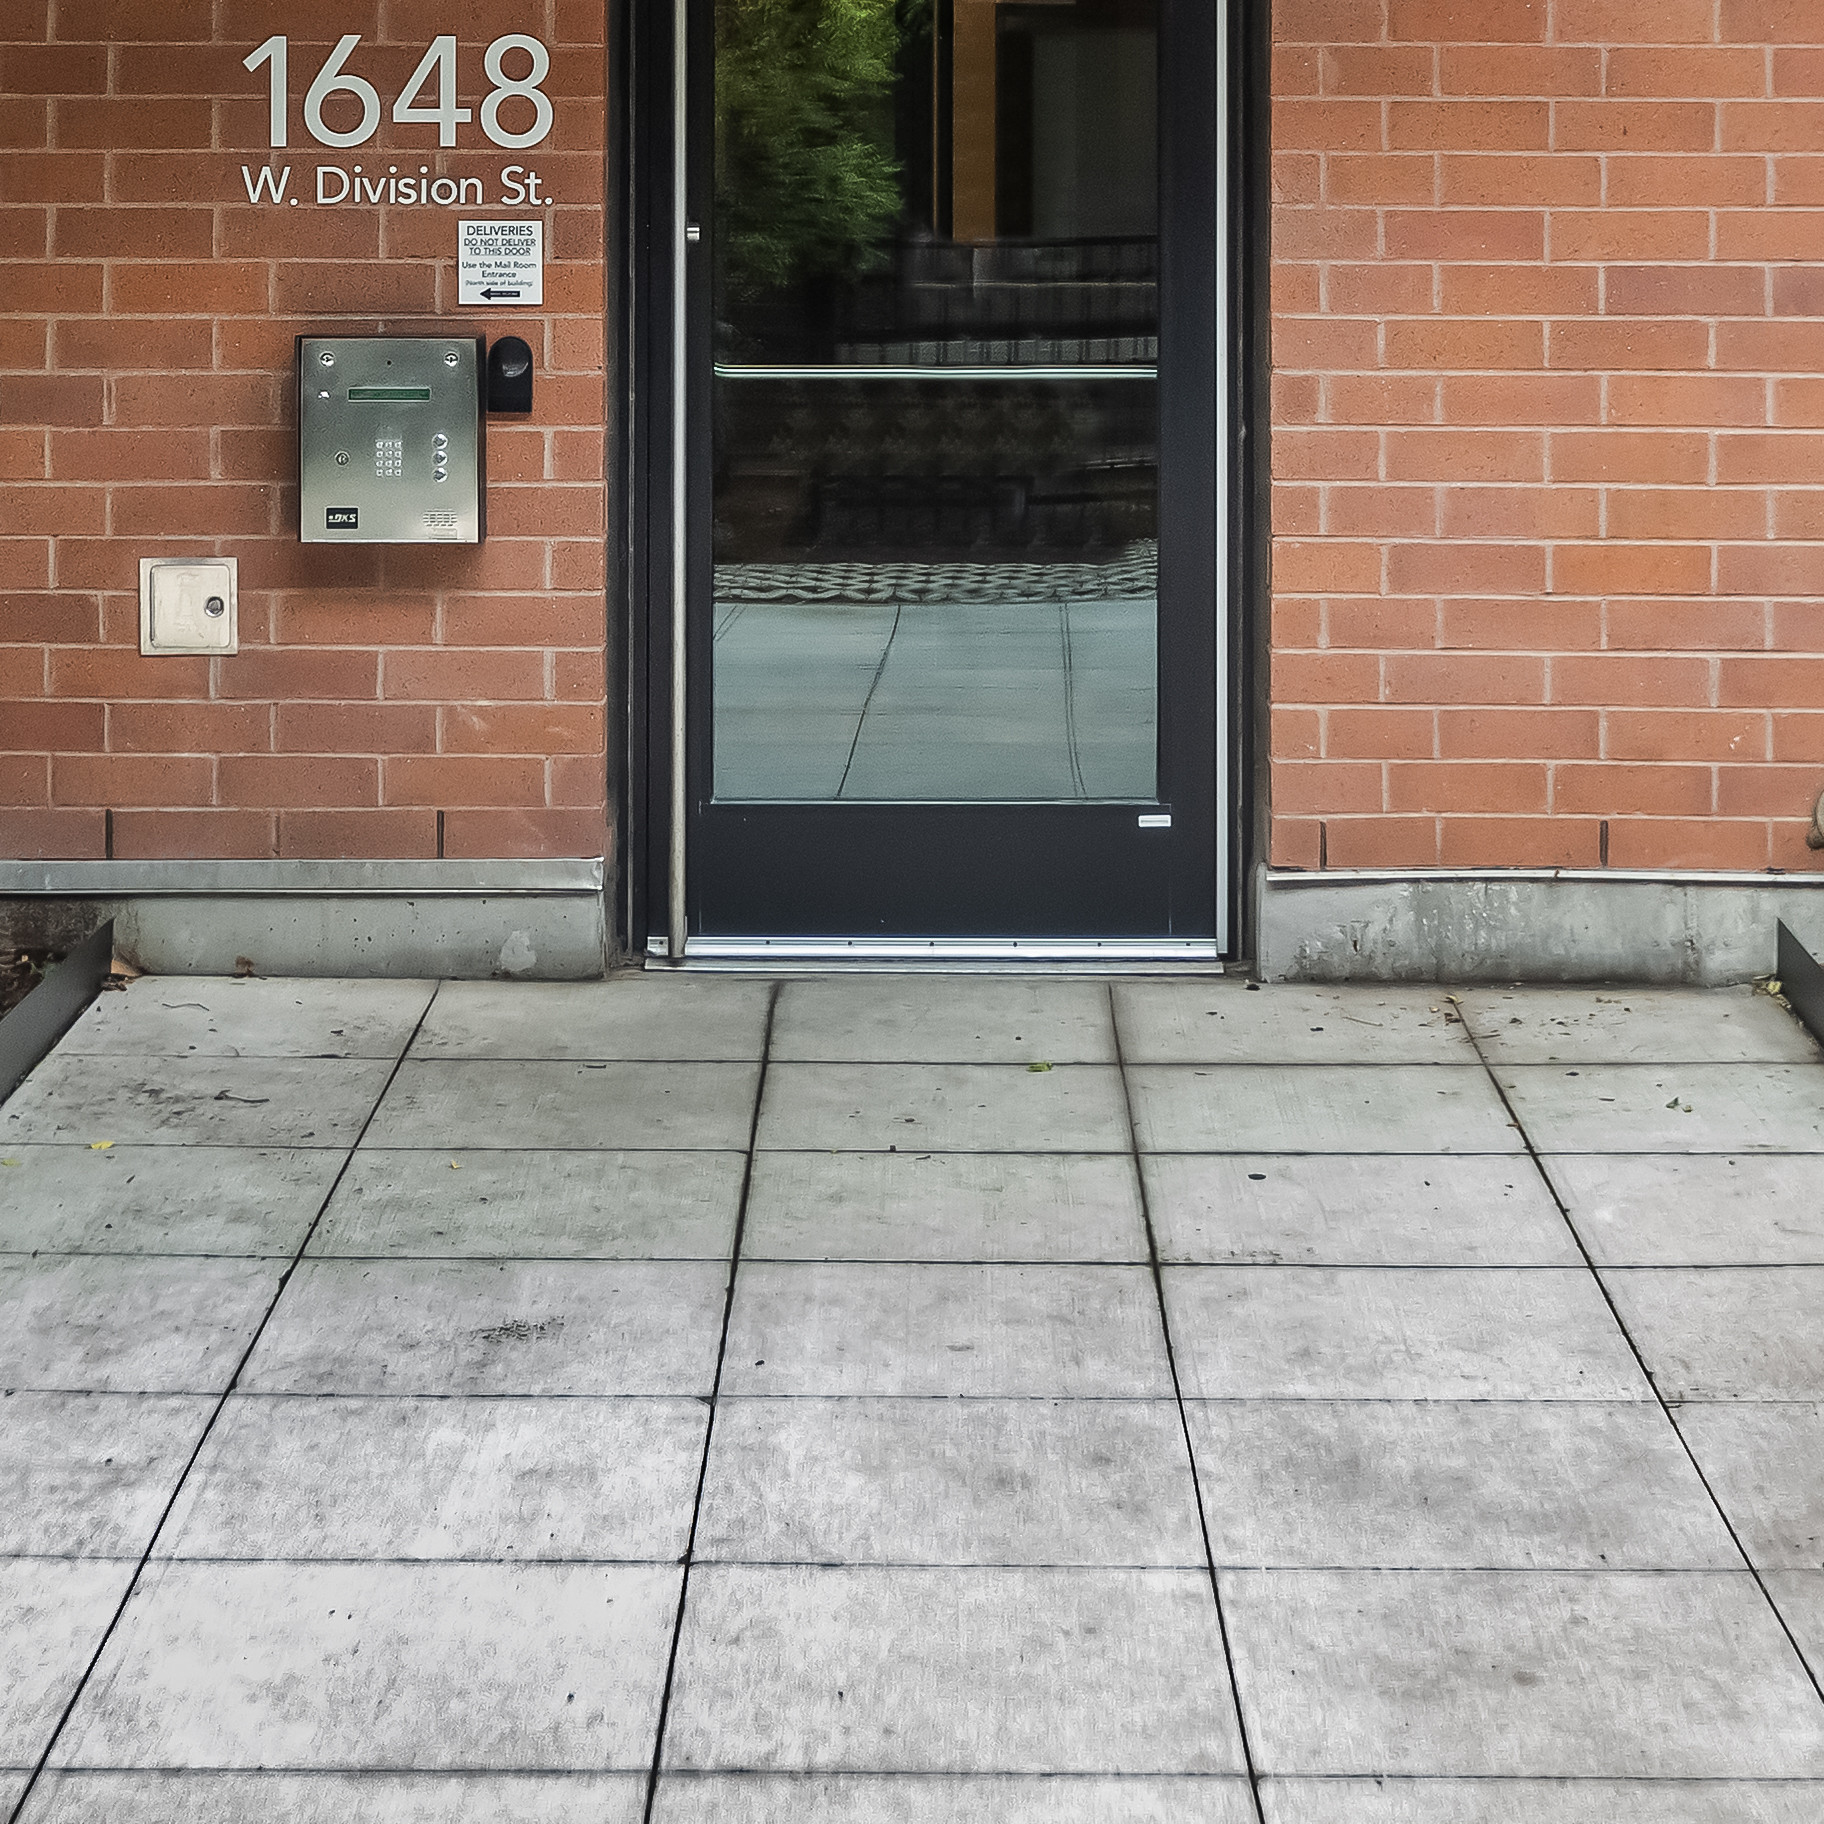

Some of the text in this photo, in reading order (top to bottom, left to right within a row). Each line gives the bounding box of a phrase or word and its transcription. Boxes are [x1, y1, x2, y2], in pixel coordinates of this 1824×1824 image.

[242, 33, 554, 149] 1648
[241, 164, 554, 207] W. Division St.
[466, 225, 534, 237] DELIVERIES
[463, 238, 537, 247] DO NOT DELIVER
[469, 247, 532, 256] TO THIS DOOR
[461, 261, 537, 269] Use the Mail Room
[481, 270, 517, 278] Entrance
